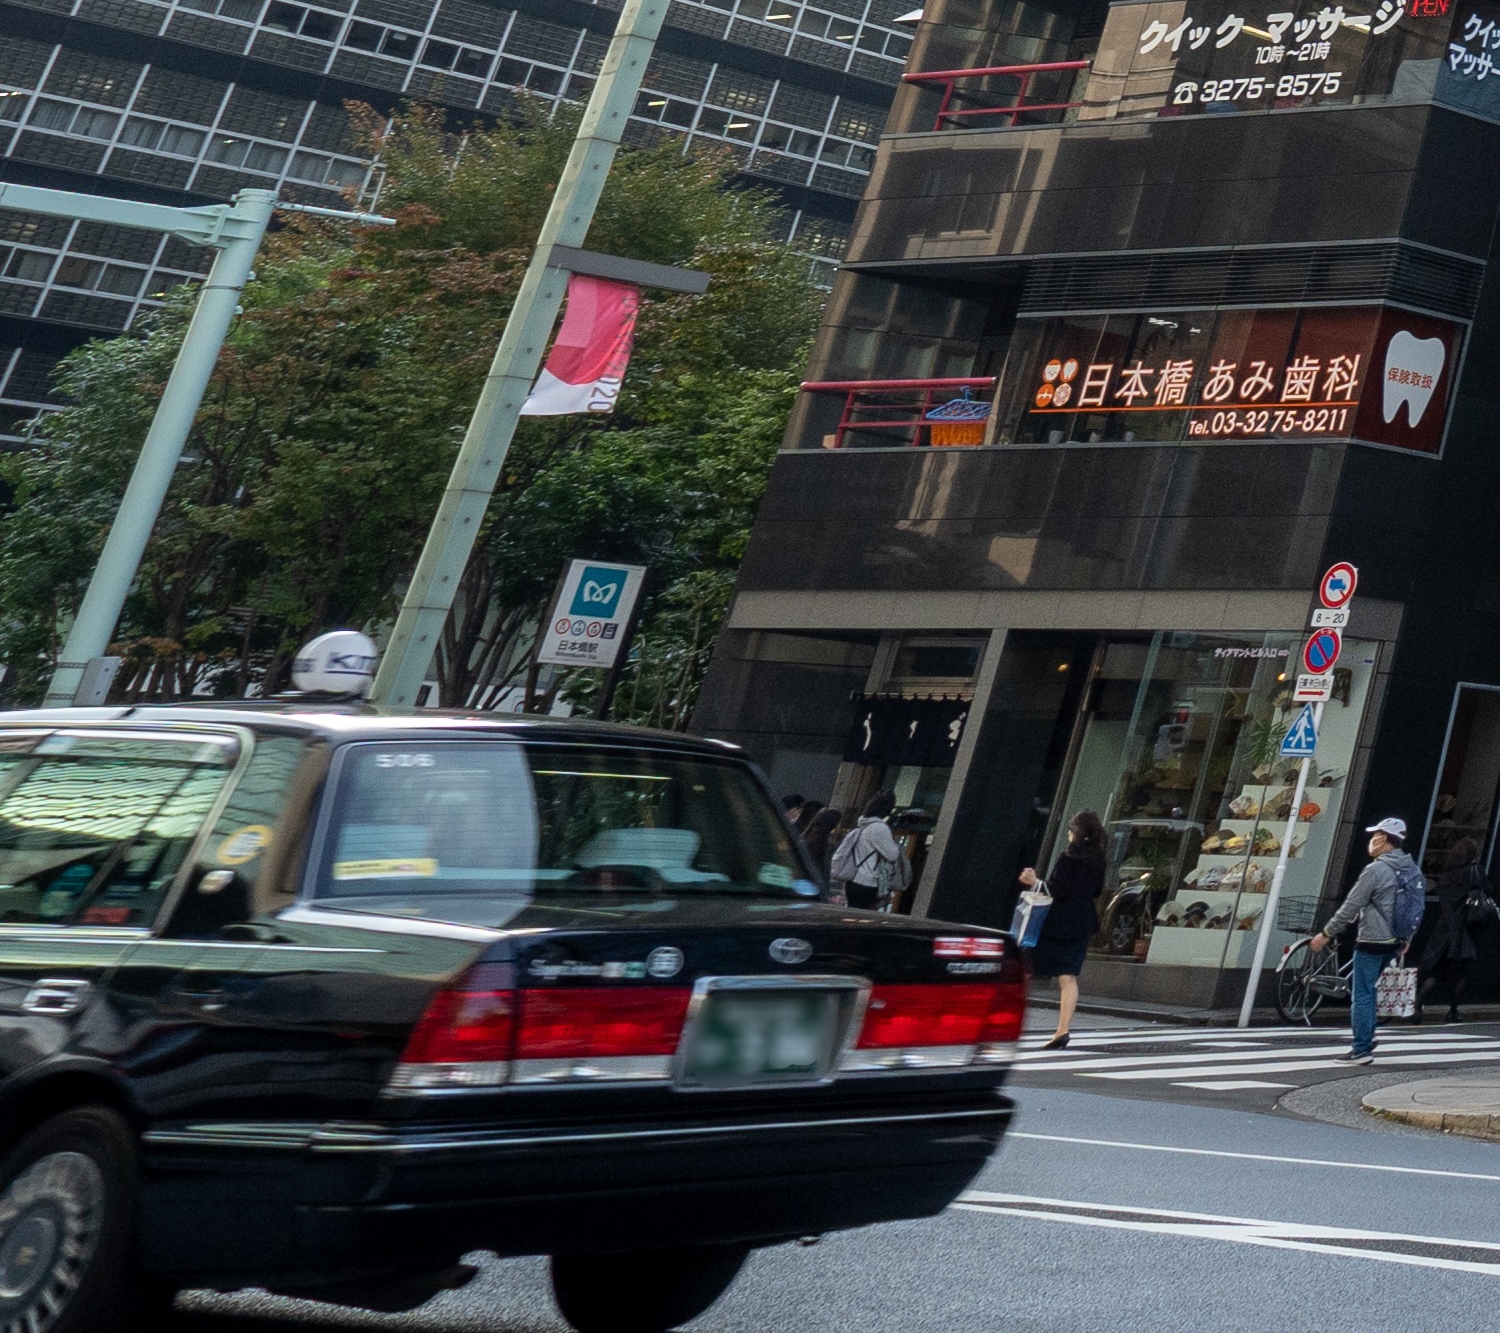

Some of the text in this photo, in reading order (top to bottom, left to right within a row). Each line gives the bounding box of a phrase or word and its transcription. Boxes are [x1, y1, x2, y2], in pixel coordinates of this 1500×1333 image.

[1139, 14, 1244, 54] クイック
[1200, 71, 1342, 103] 3275-8575
[1076, 354, 1362, 408] 日本橋 あみ歯科
[1387, 366, 1435, 390] 保険取扱
[1188, 408, 1348, 435] Tel. 03-3275-8211
